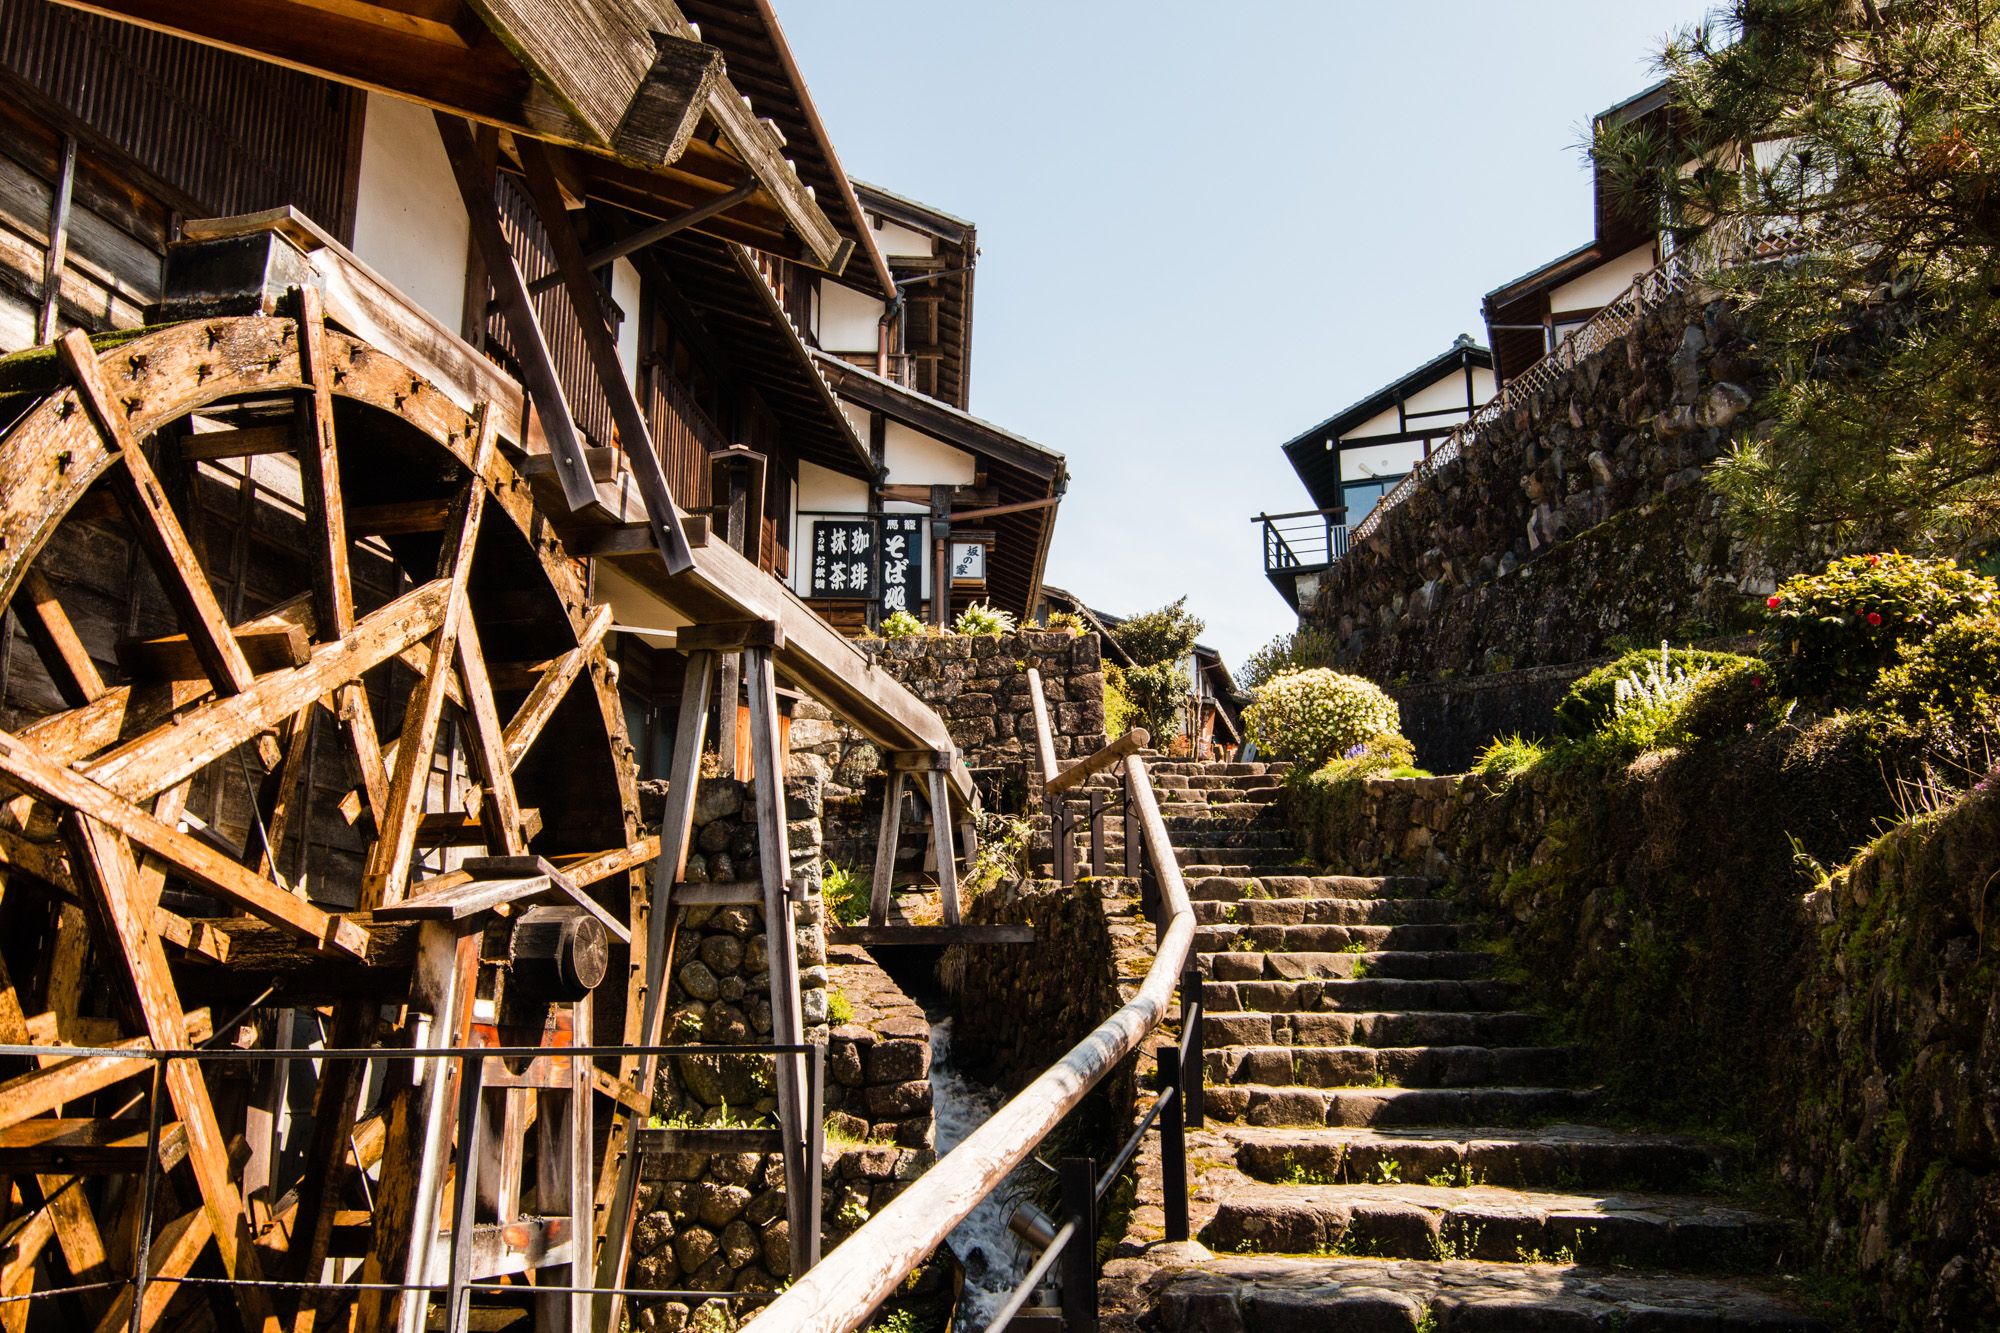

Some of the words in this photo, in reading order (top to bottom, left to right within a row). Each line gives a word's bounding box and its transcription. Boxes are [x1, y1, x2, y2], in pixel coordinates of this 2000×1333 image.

[886, 519, 917, 531] 馬籠
[828, 527, 848, 591] 抹茶
[850, 526, 870, 591] 珈琲
[884, 534, 910, 611] そば処
[955, 545, 980, 576] 坂の家
